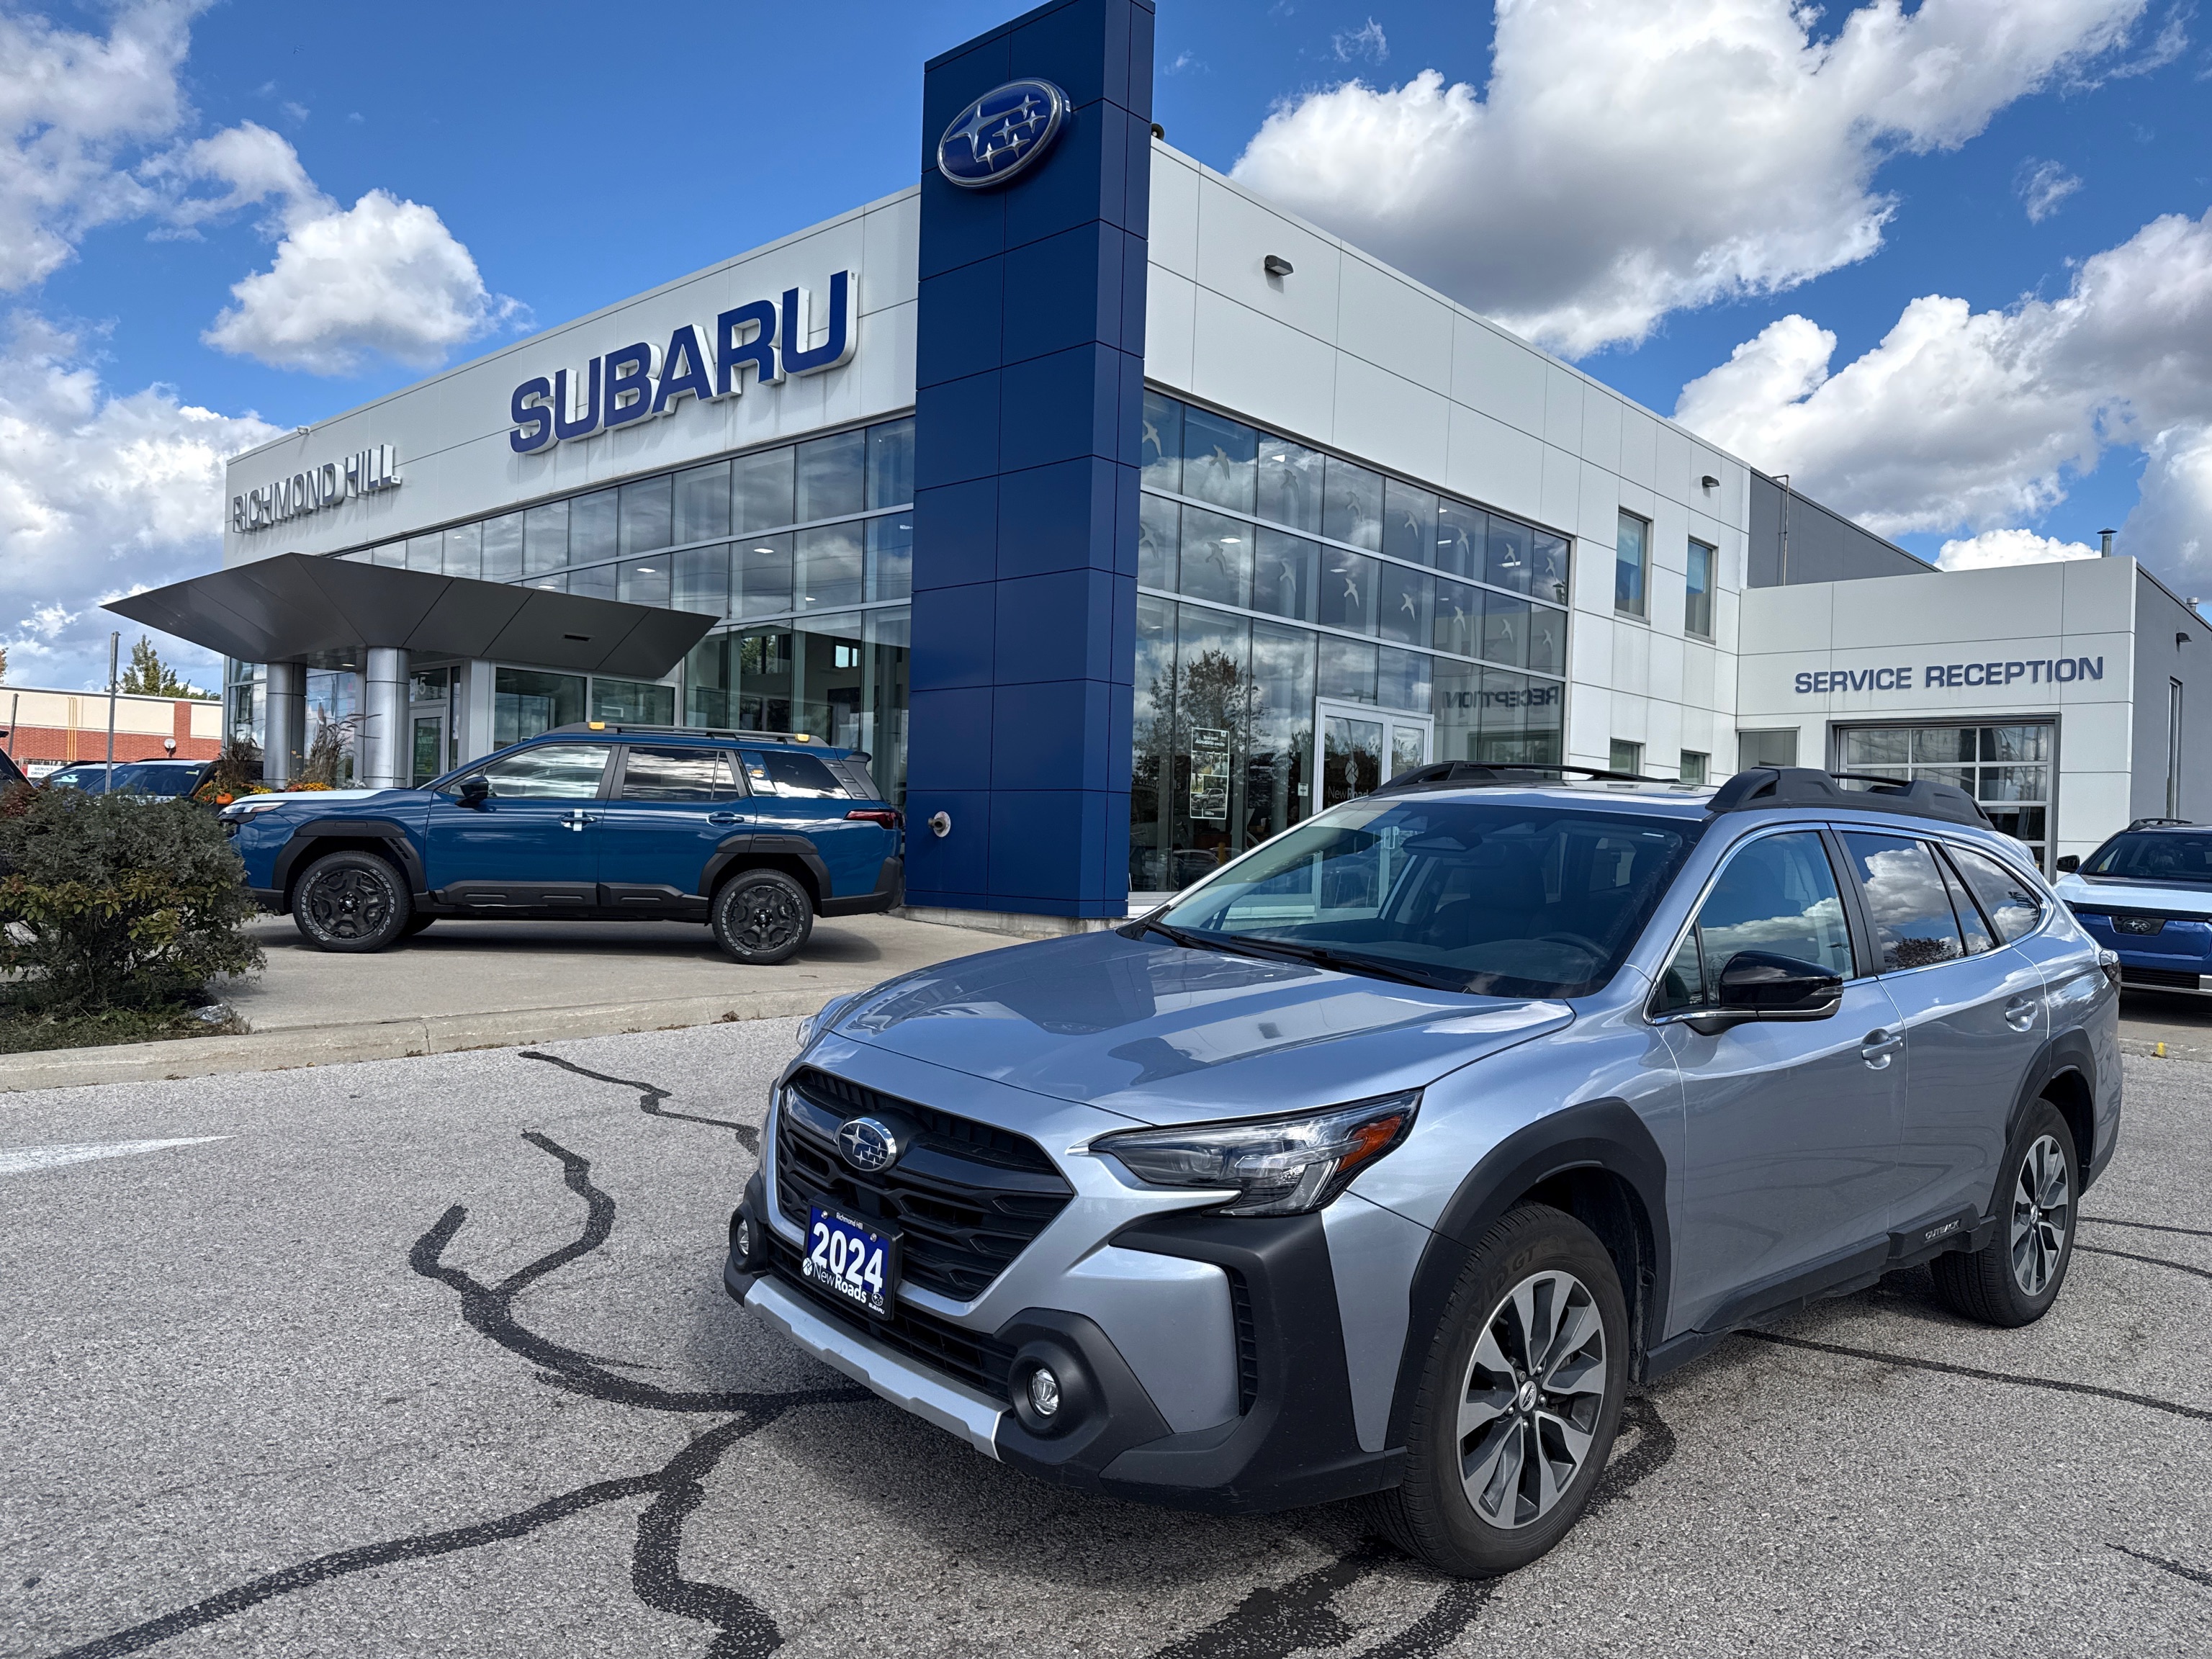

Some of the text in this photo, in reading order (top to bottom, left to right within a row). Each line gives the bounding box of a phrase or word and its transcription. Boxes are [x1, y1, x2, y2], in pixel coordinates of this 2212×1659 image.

[509, 269, 855, 454] SUBARU
[233, 444, 398, 533] RICHMOND HILL
[1794, 656, 2103, 693] SERVICE RECEPTION
[1328, 786, 1372, 799] NewRoad
[836, 1212, 856, 1227] Richmond
[1925, 1219, 1960, 1240] OUTBACK
[811, 1222, 883, 1294] 2024
[1512, 1244, 1537, 1272] GT
[868, 1302, 885, 1315] SUBARU
